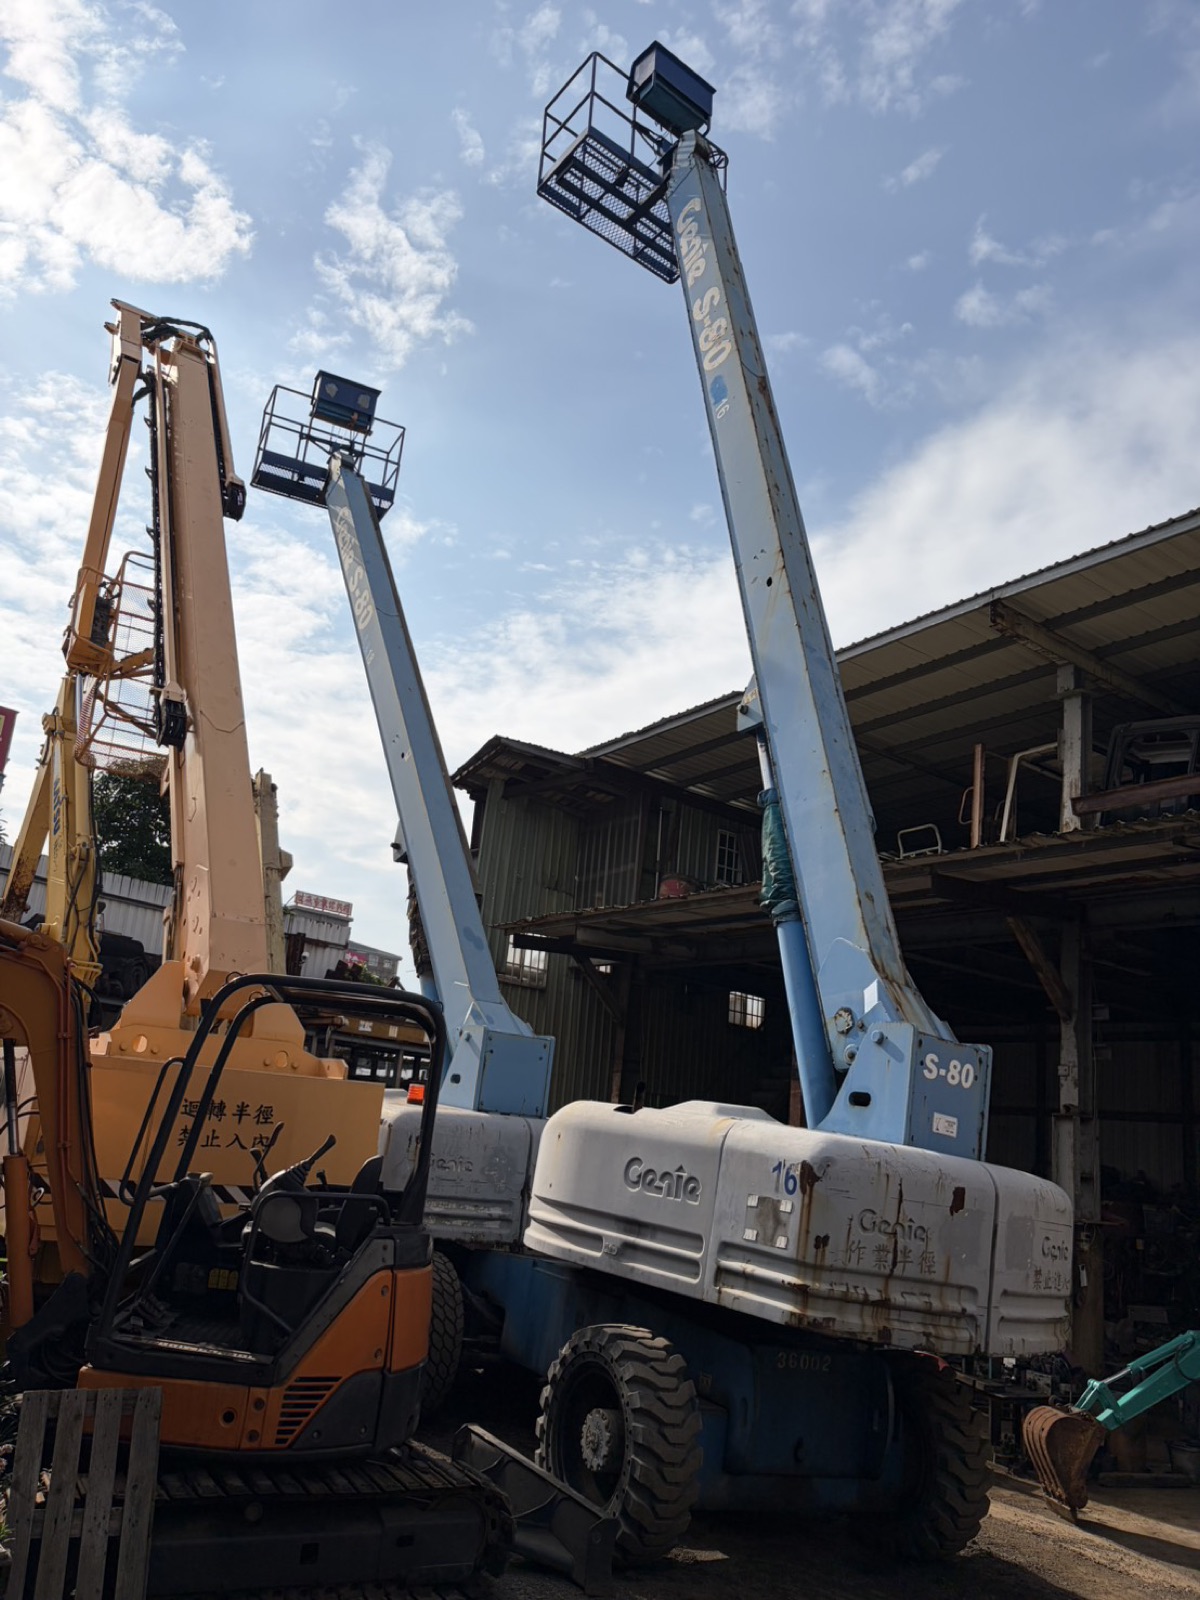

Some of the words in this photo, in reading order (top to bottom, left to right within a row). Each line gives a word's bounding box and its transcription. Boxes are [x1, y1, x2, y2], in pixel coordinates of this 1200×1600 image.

[676, 197, 708, 287] Genie
[693, 286, 732, 372] S-80
[715, 398, 730, 420] 16
[350, 565, 374, 630] S-80
[923, 1053, 975, 1089] S-80
[623, 1156, 702, 1206] Genie
[771, 1159, 798, 1196] 16
[858, 1207, 930, 1244] Genie
